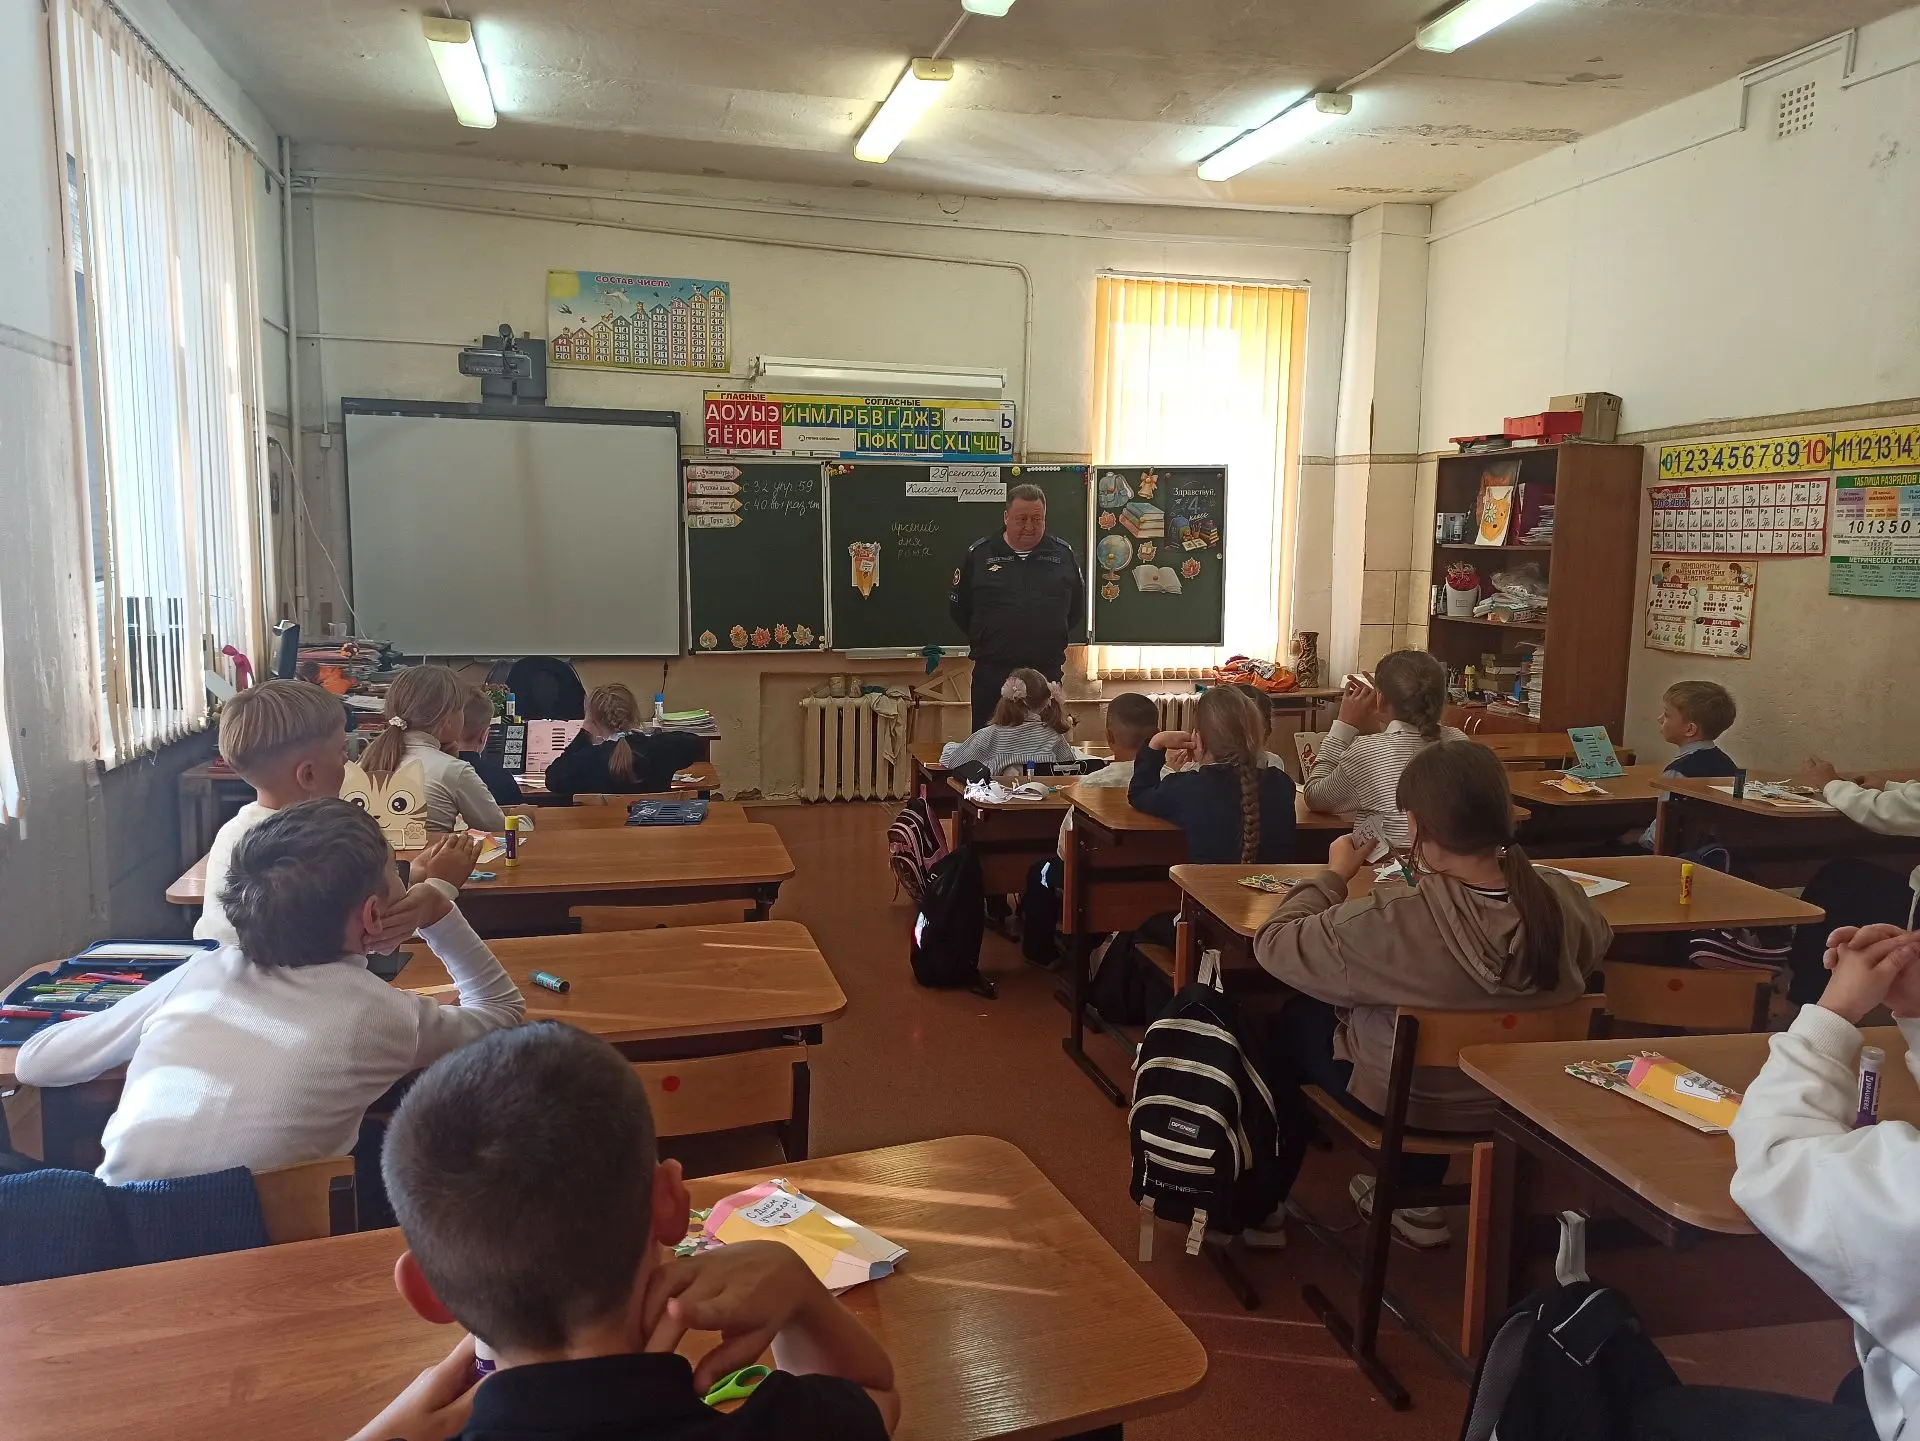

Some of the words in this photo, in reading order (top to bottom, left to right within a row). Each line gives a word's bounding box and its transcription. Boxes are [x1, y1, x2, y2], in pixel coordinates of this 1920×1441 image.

[596, 276, 634, 285] СОСТАВ
[637, 280, 671, 288] ЧИСЛА
[720, 393, 766, 401] ГЛАСНЫЕ
[865, 398, 921, 407] СОГЛАСНЫЕ
[1803, 439, 1826, 465] 10
[1856, 436, 1872, 461] 12
[1875, 435, 1891, 460] 13
[1894, 433, 1912, 458] 14
[932, 468, 948, 479] 29
[1854, 477, 1880, 487] ТАБЛИЦА
[1882, 475, 1917, 485] РАЗРЯДОВ
[907, 483, 958, 493] Классная
[1188, 496, 1201, 514] 4
